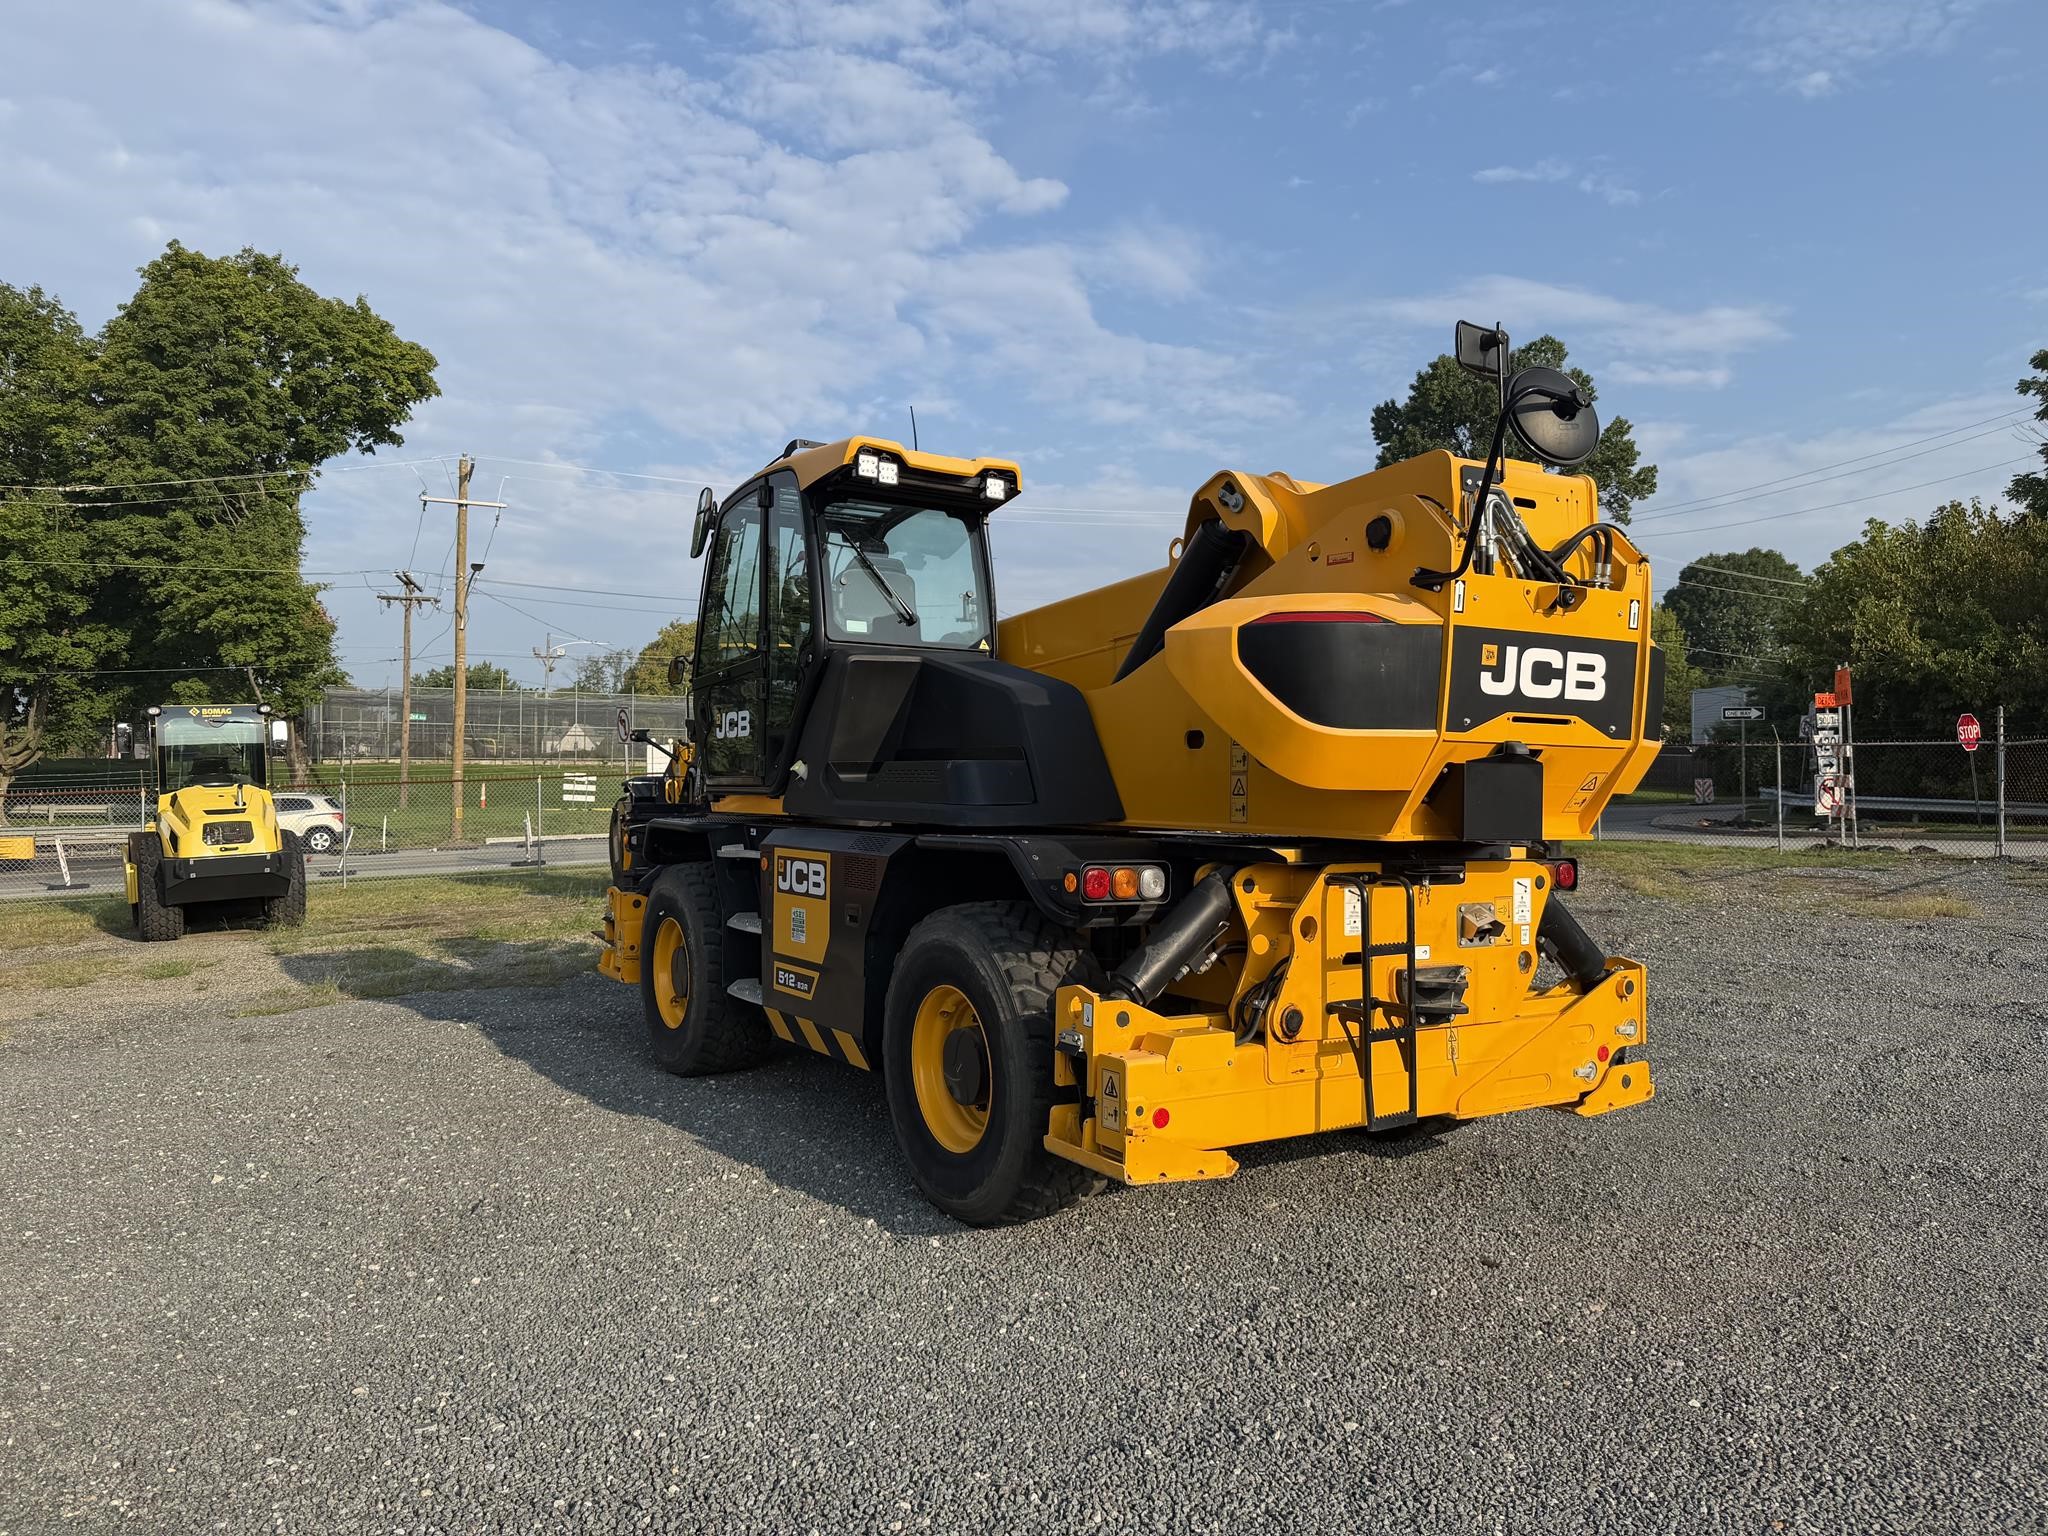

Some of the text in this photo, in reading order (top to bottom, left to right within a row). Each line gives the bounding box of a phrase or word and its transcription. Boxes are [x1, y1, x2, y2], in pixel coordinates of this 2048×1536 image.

[1480, 645, 1606, 701] JCB
[716, 711, 750, 739] JCB
[1959, 725, 1978, 739] STOP
[778, 860, 826, 896] JCB
